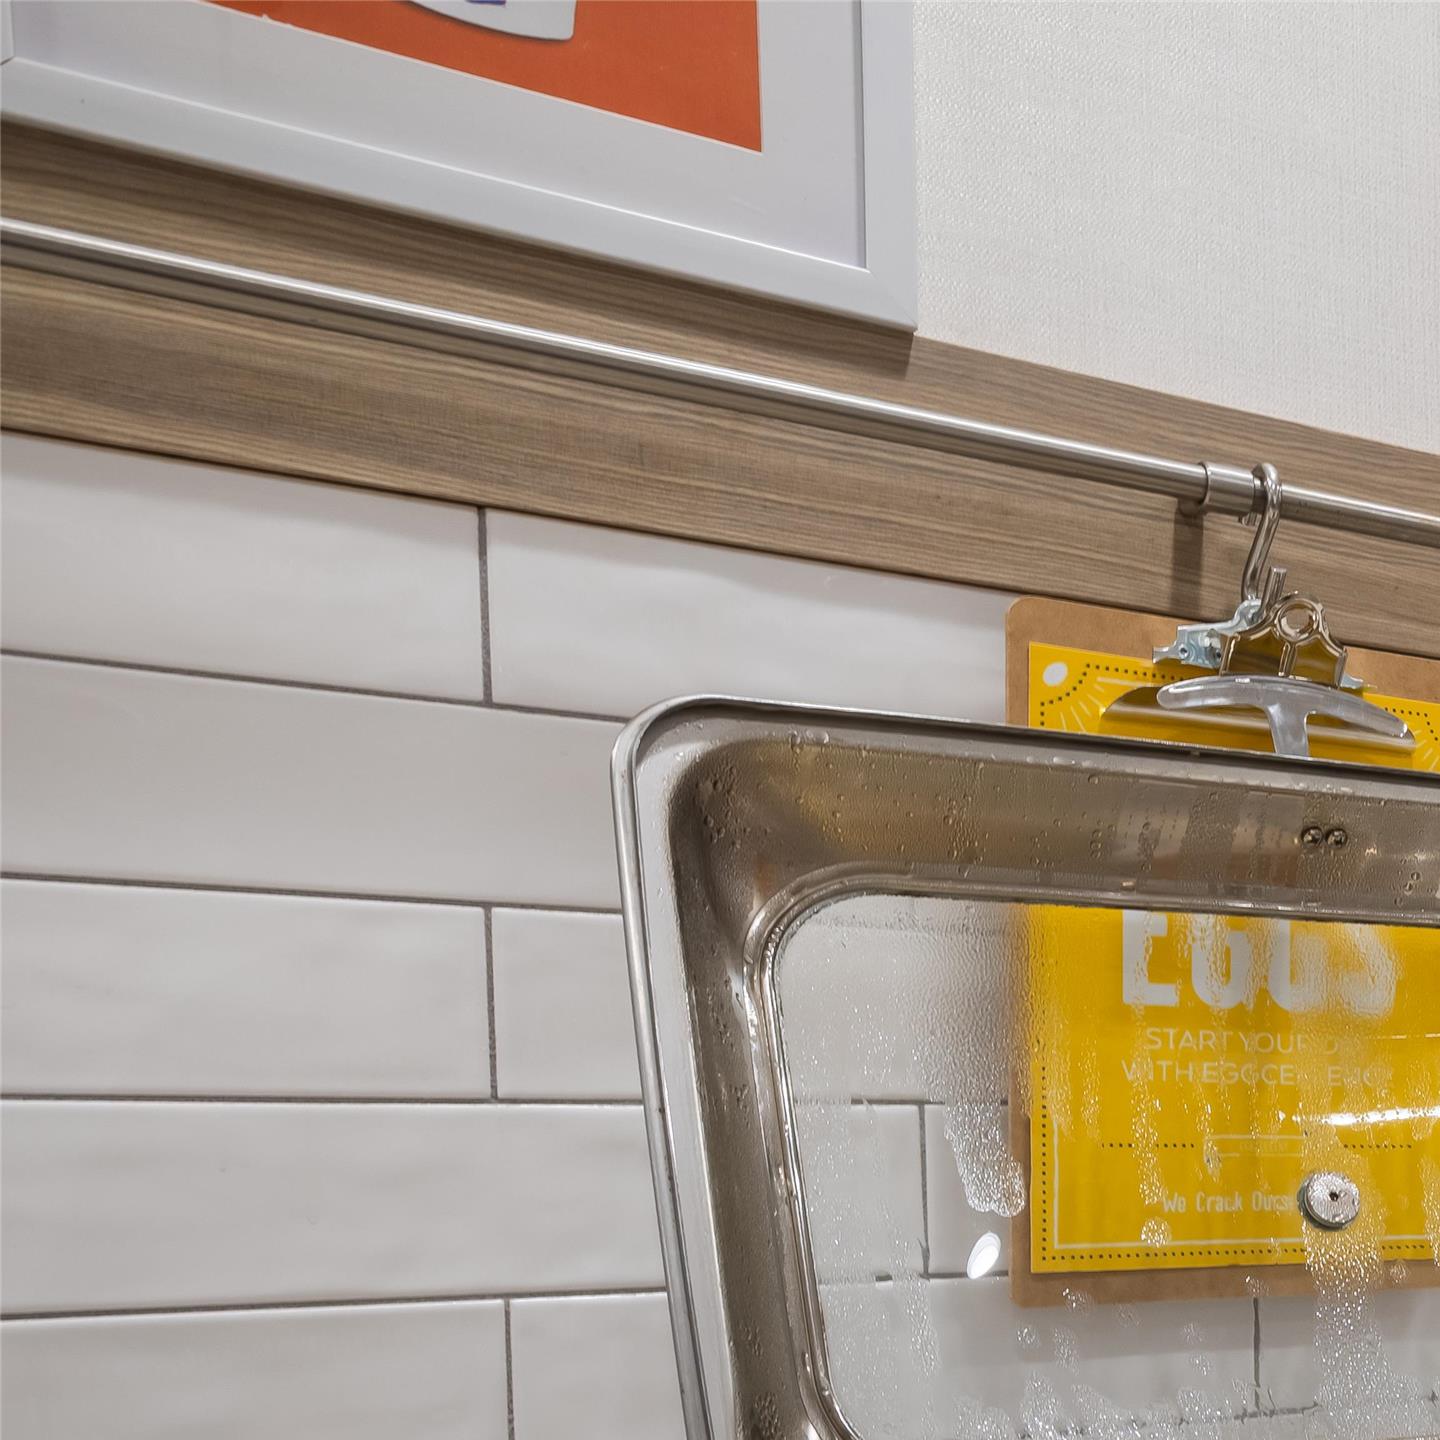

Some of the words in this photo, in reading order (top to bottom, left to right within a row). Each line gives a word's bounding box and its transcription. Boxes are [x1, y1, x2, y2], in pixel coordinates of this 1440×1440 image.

[1145, 1027, 1232, 1051] START
[1121, 1059, 1193, 1085] WITH
[1162, 1191, 1186, 1213] We
[1196, 1190, 1243, 1212] Crack
